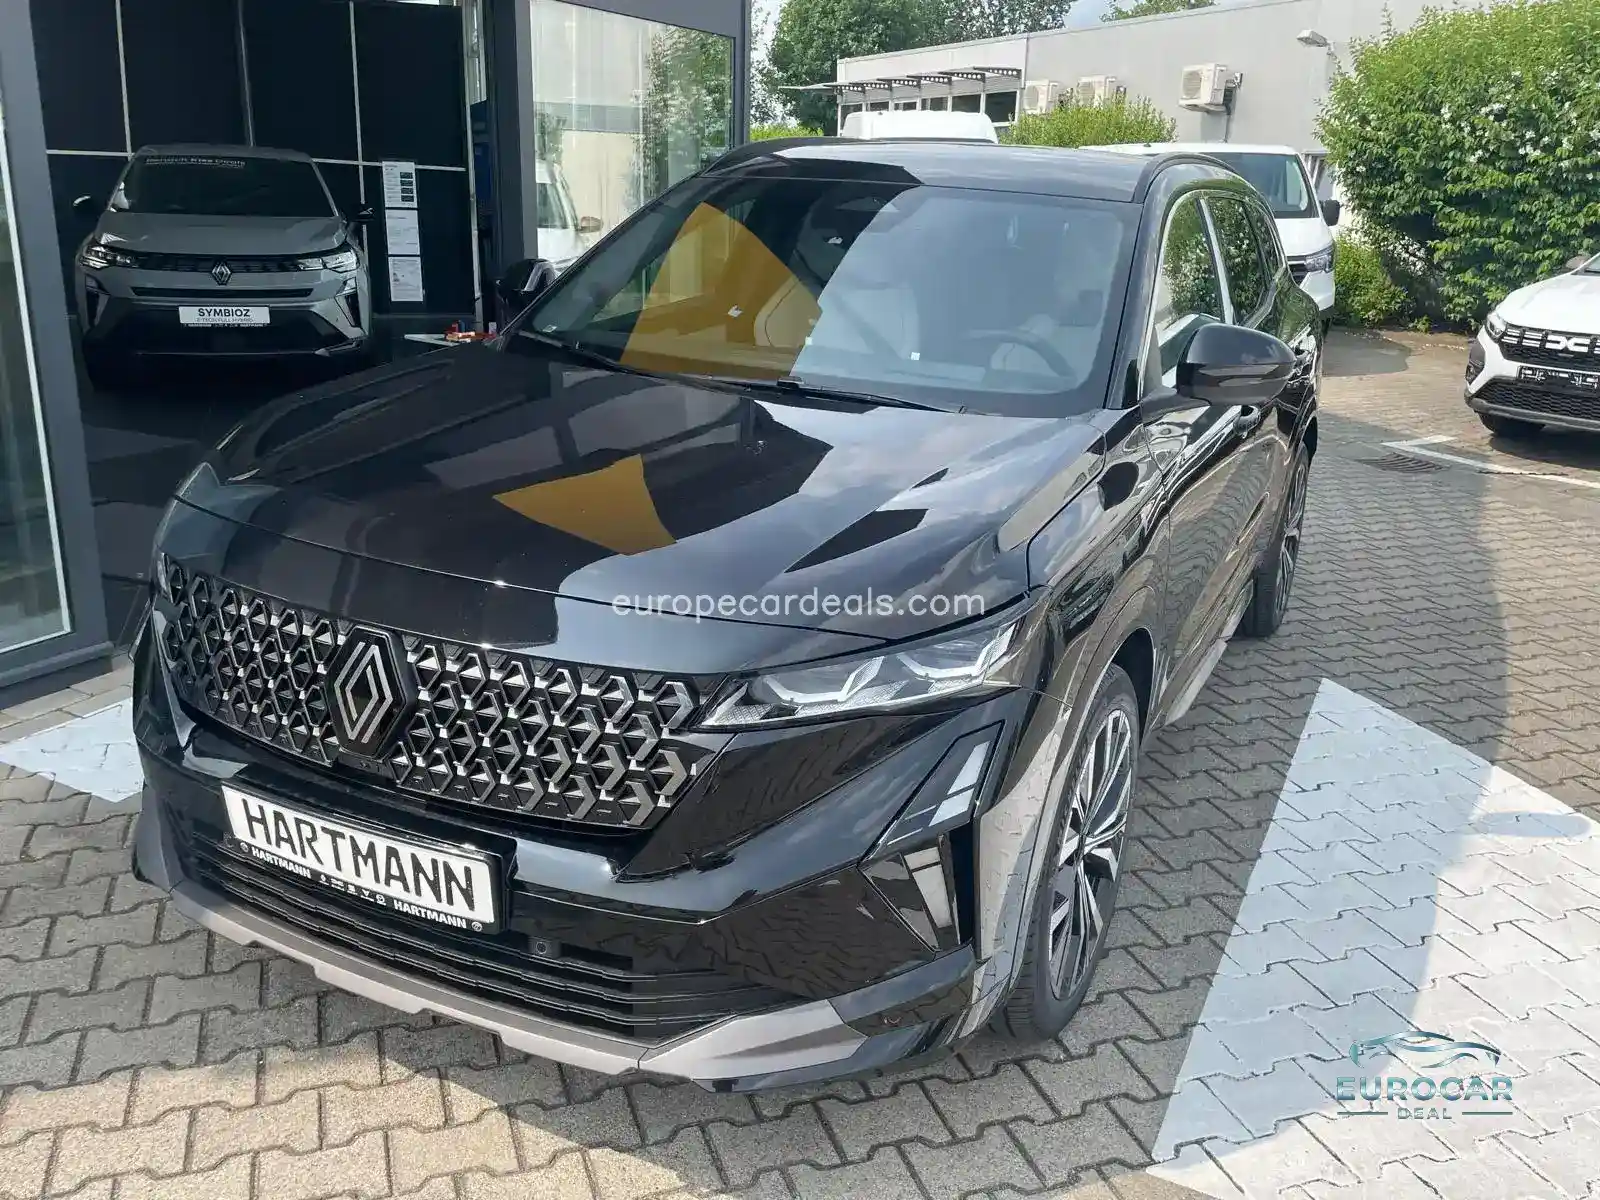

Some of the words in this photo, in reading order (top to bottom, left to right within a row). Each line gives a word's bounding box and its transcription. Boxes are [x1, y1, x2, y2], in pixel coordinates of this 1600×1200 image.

[197, 307, 251, 317] SYMBIOZ
[241, 797, 475, 912] HARTMANN
[251, 847, 312, 879] HARTMANN
[393, 899, 467, 930] HARTMANN
